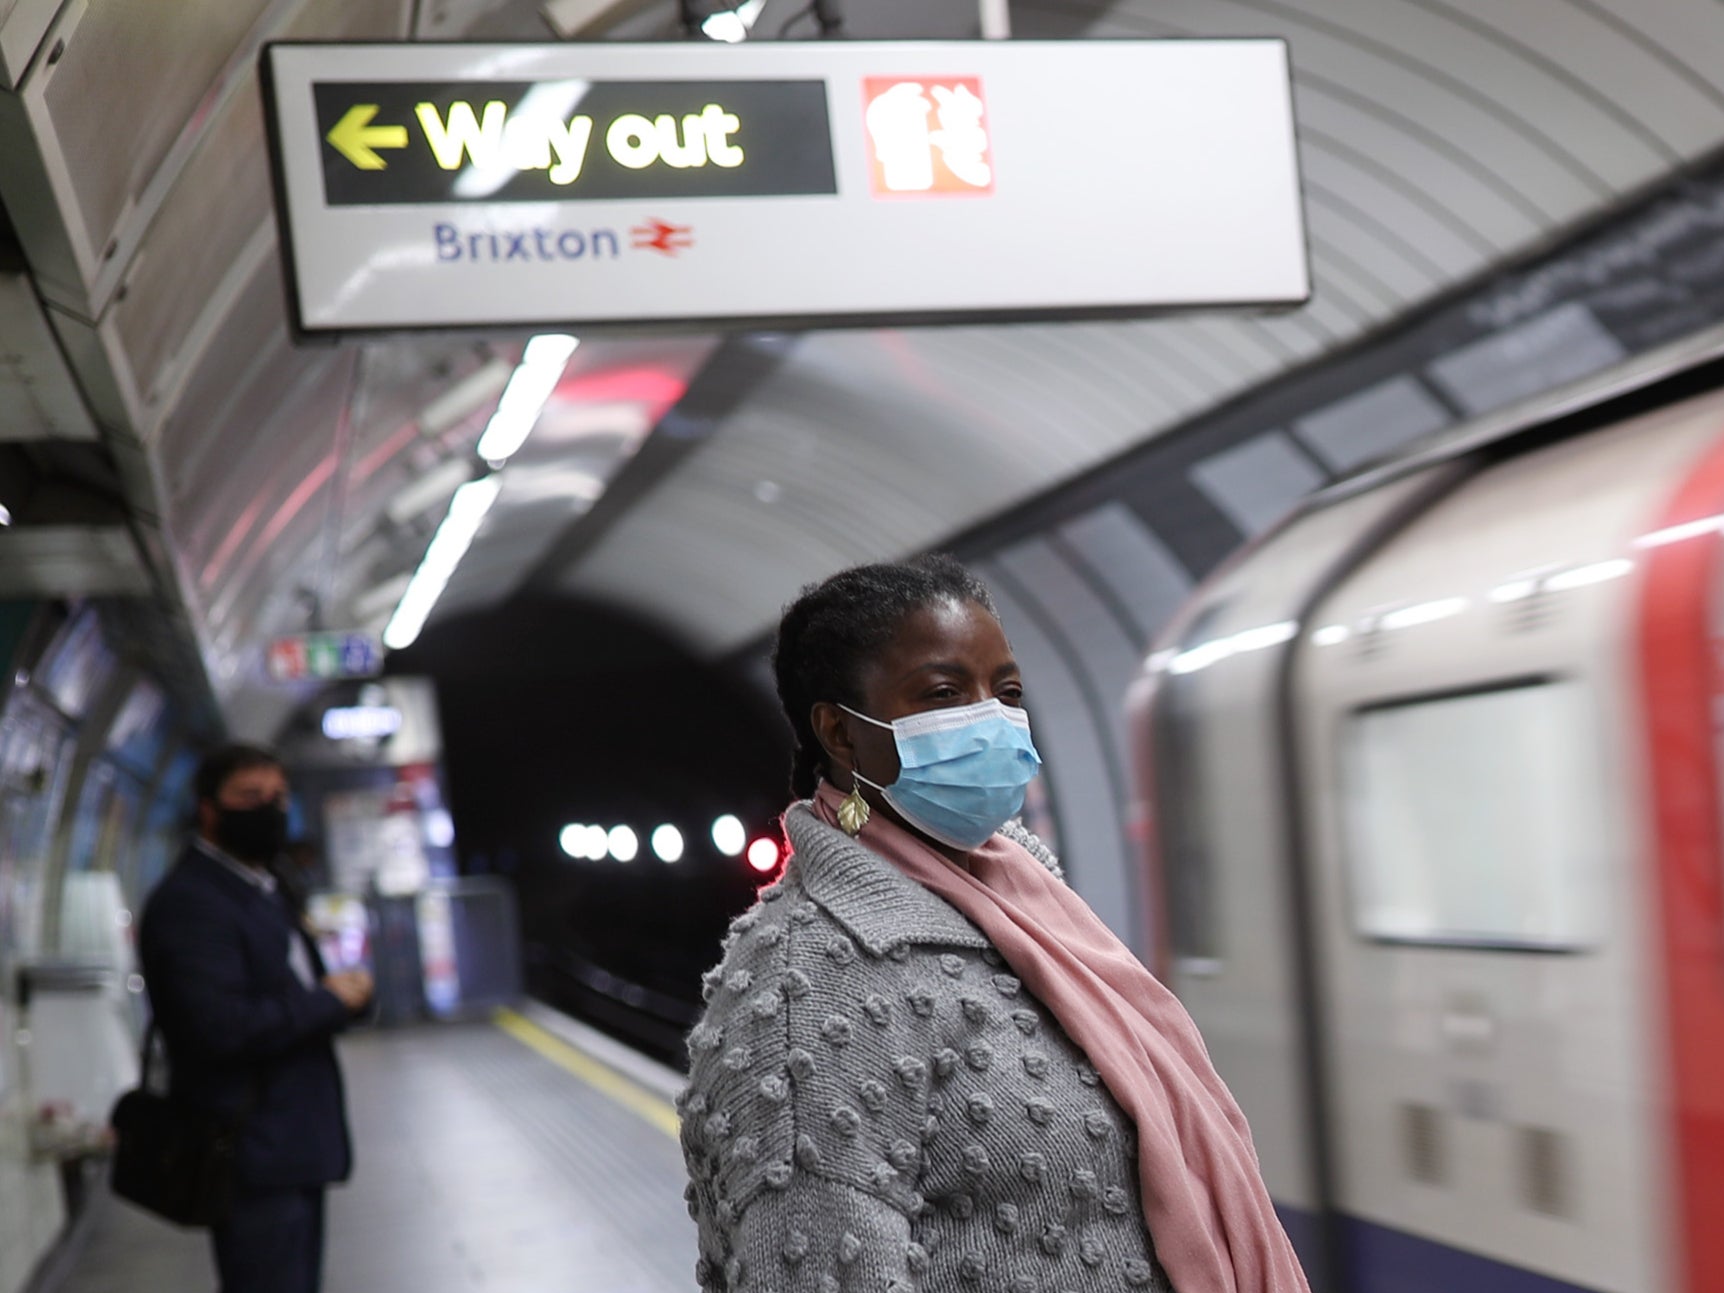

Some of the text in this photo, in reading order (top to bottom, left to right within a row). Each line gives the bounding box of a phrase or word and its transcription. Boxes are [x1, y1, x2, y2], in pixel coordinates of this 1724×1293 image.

[414, 101, 745, 186] Way out
[432, 223, 620, 263] Brixton
